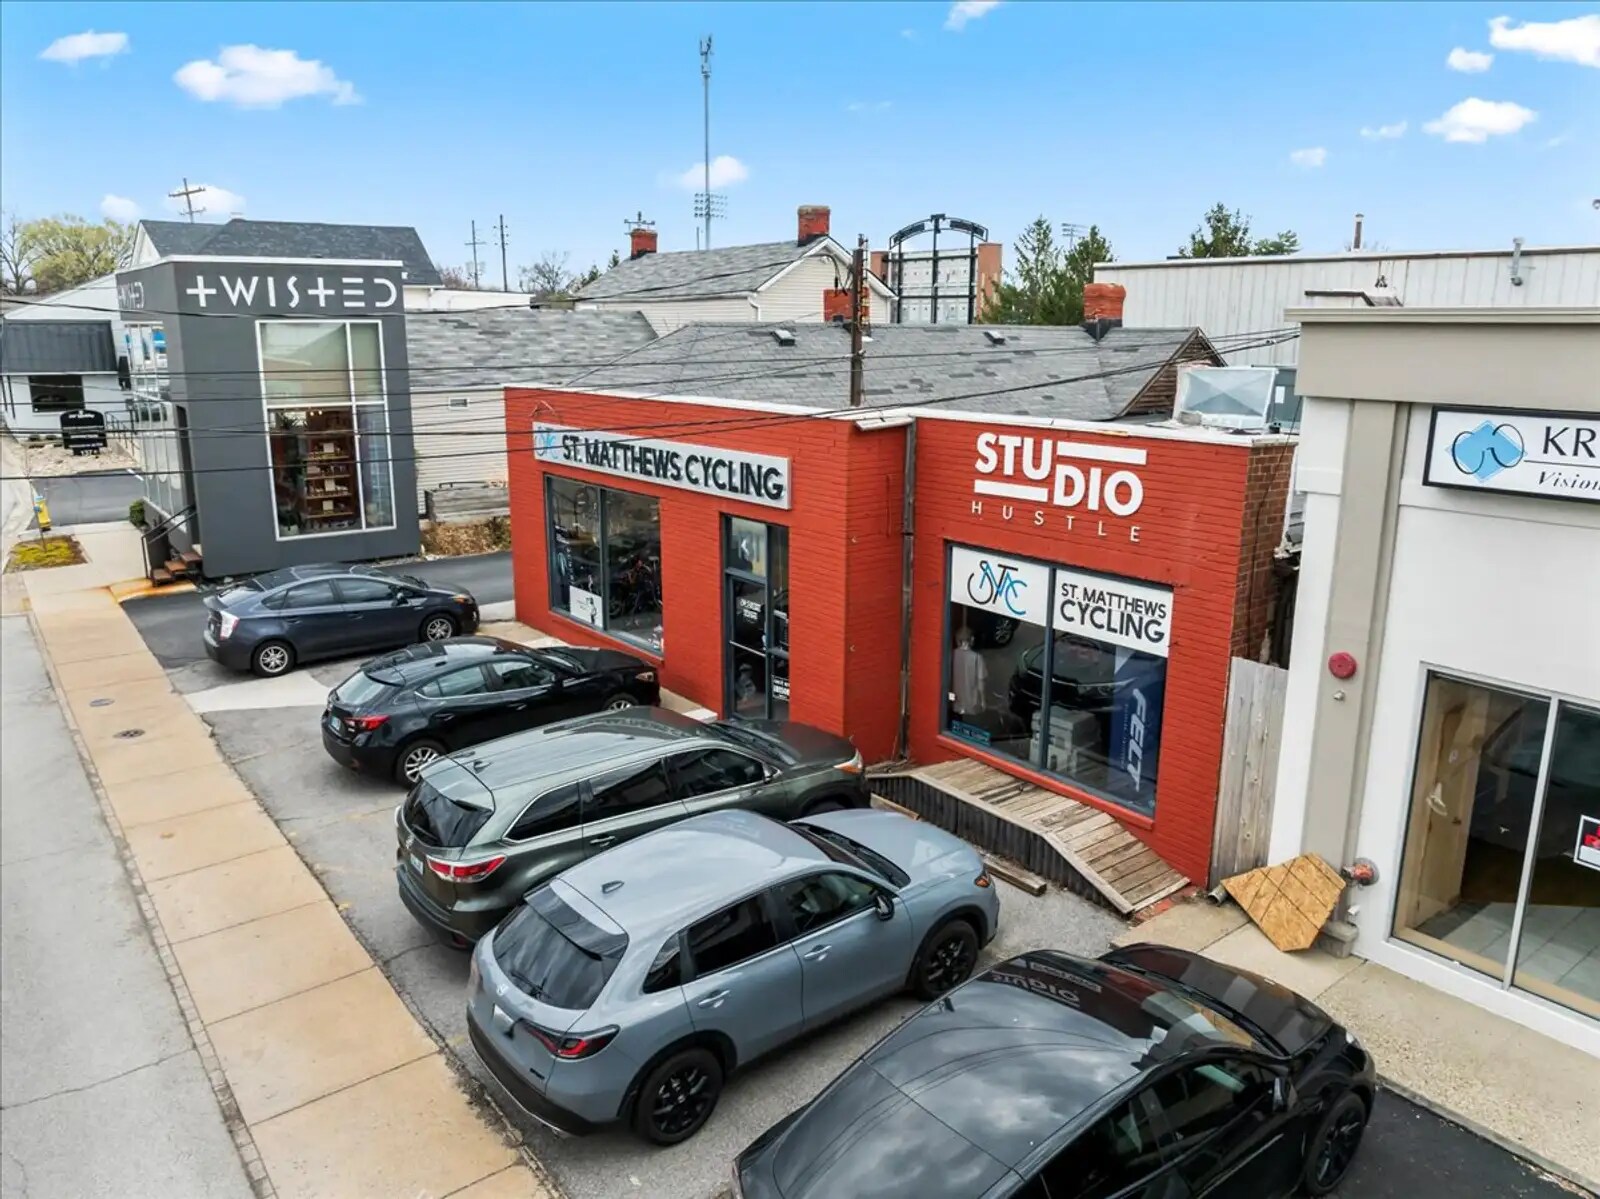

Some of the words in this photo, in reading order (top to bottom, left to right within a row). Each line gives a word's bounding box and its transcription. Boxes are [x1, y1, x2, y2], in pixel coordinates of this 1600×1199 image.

[186, 275, 398, 309] TWISTED
[562, 435, 582, 463] ST.
[585, 437, 682, 481] MATTHEWS
[685, 455, 784, 500] CYCLING
[974, 432, 1144, 517] STUDIO
[971, 501, 1141, 543] HUSTLE
[1060, 600, 1166, 643] CYCLING
[1061, 583, 1079, 600] ST.
[1083, 585, 1167, 619] MATTHEWS
[1127, 688, 1147, 792] FELT
